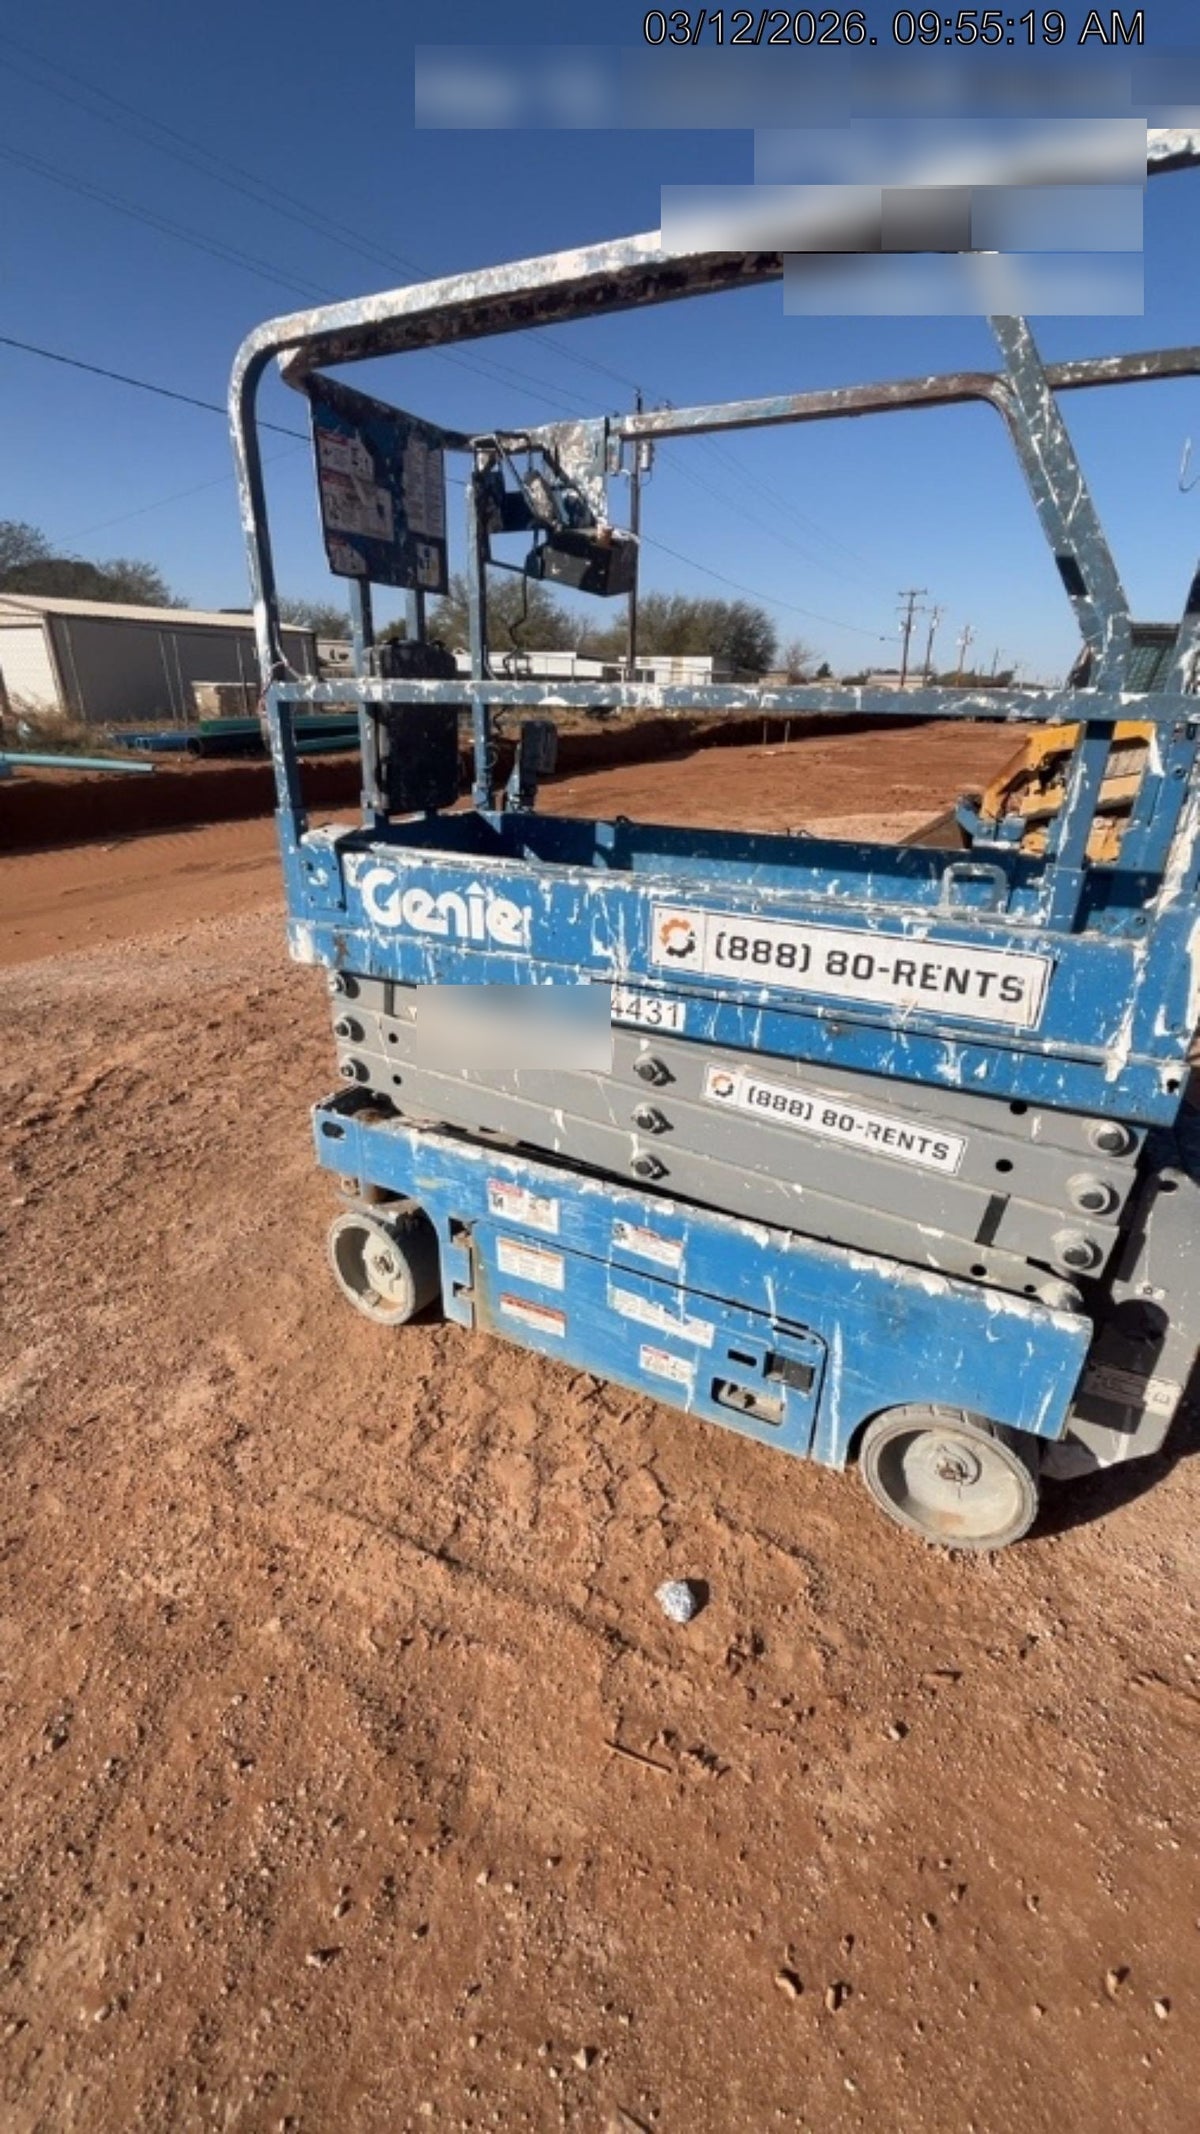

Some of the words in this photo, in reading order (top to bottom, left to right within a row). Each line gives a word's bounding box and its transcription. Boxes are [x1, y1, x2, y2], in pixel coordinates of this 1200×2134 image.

[361, 867, 532, 947] Genie
[714, 930, 811, 973] (888)
[825, 949, 1025, 1004] 80-RENTS
[746, 1084, 813, 1121] (888)
[821, 1110, 951, 1162] 80-RENTS
